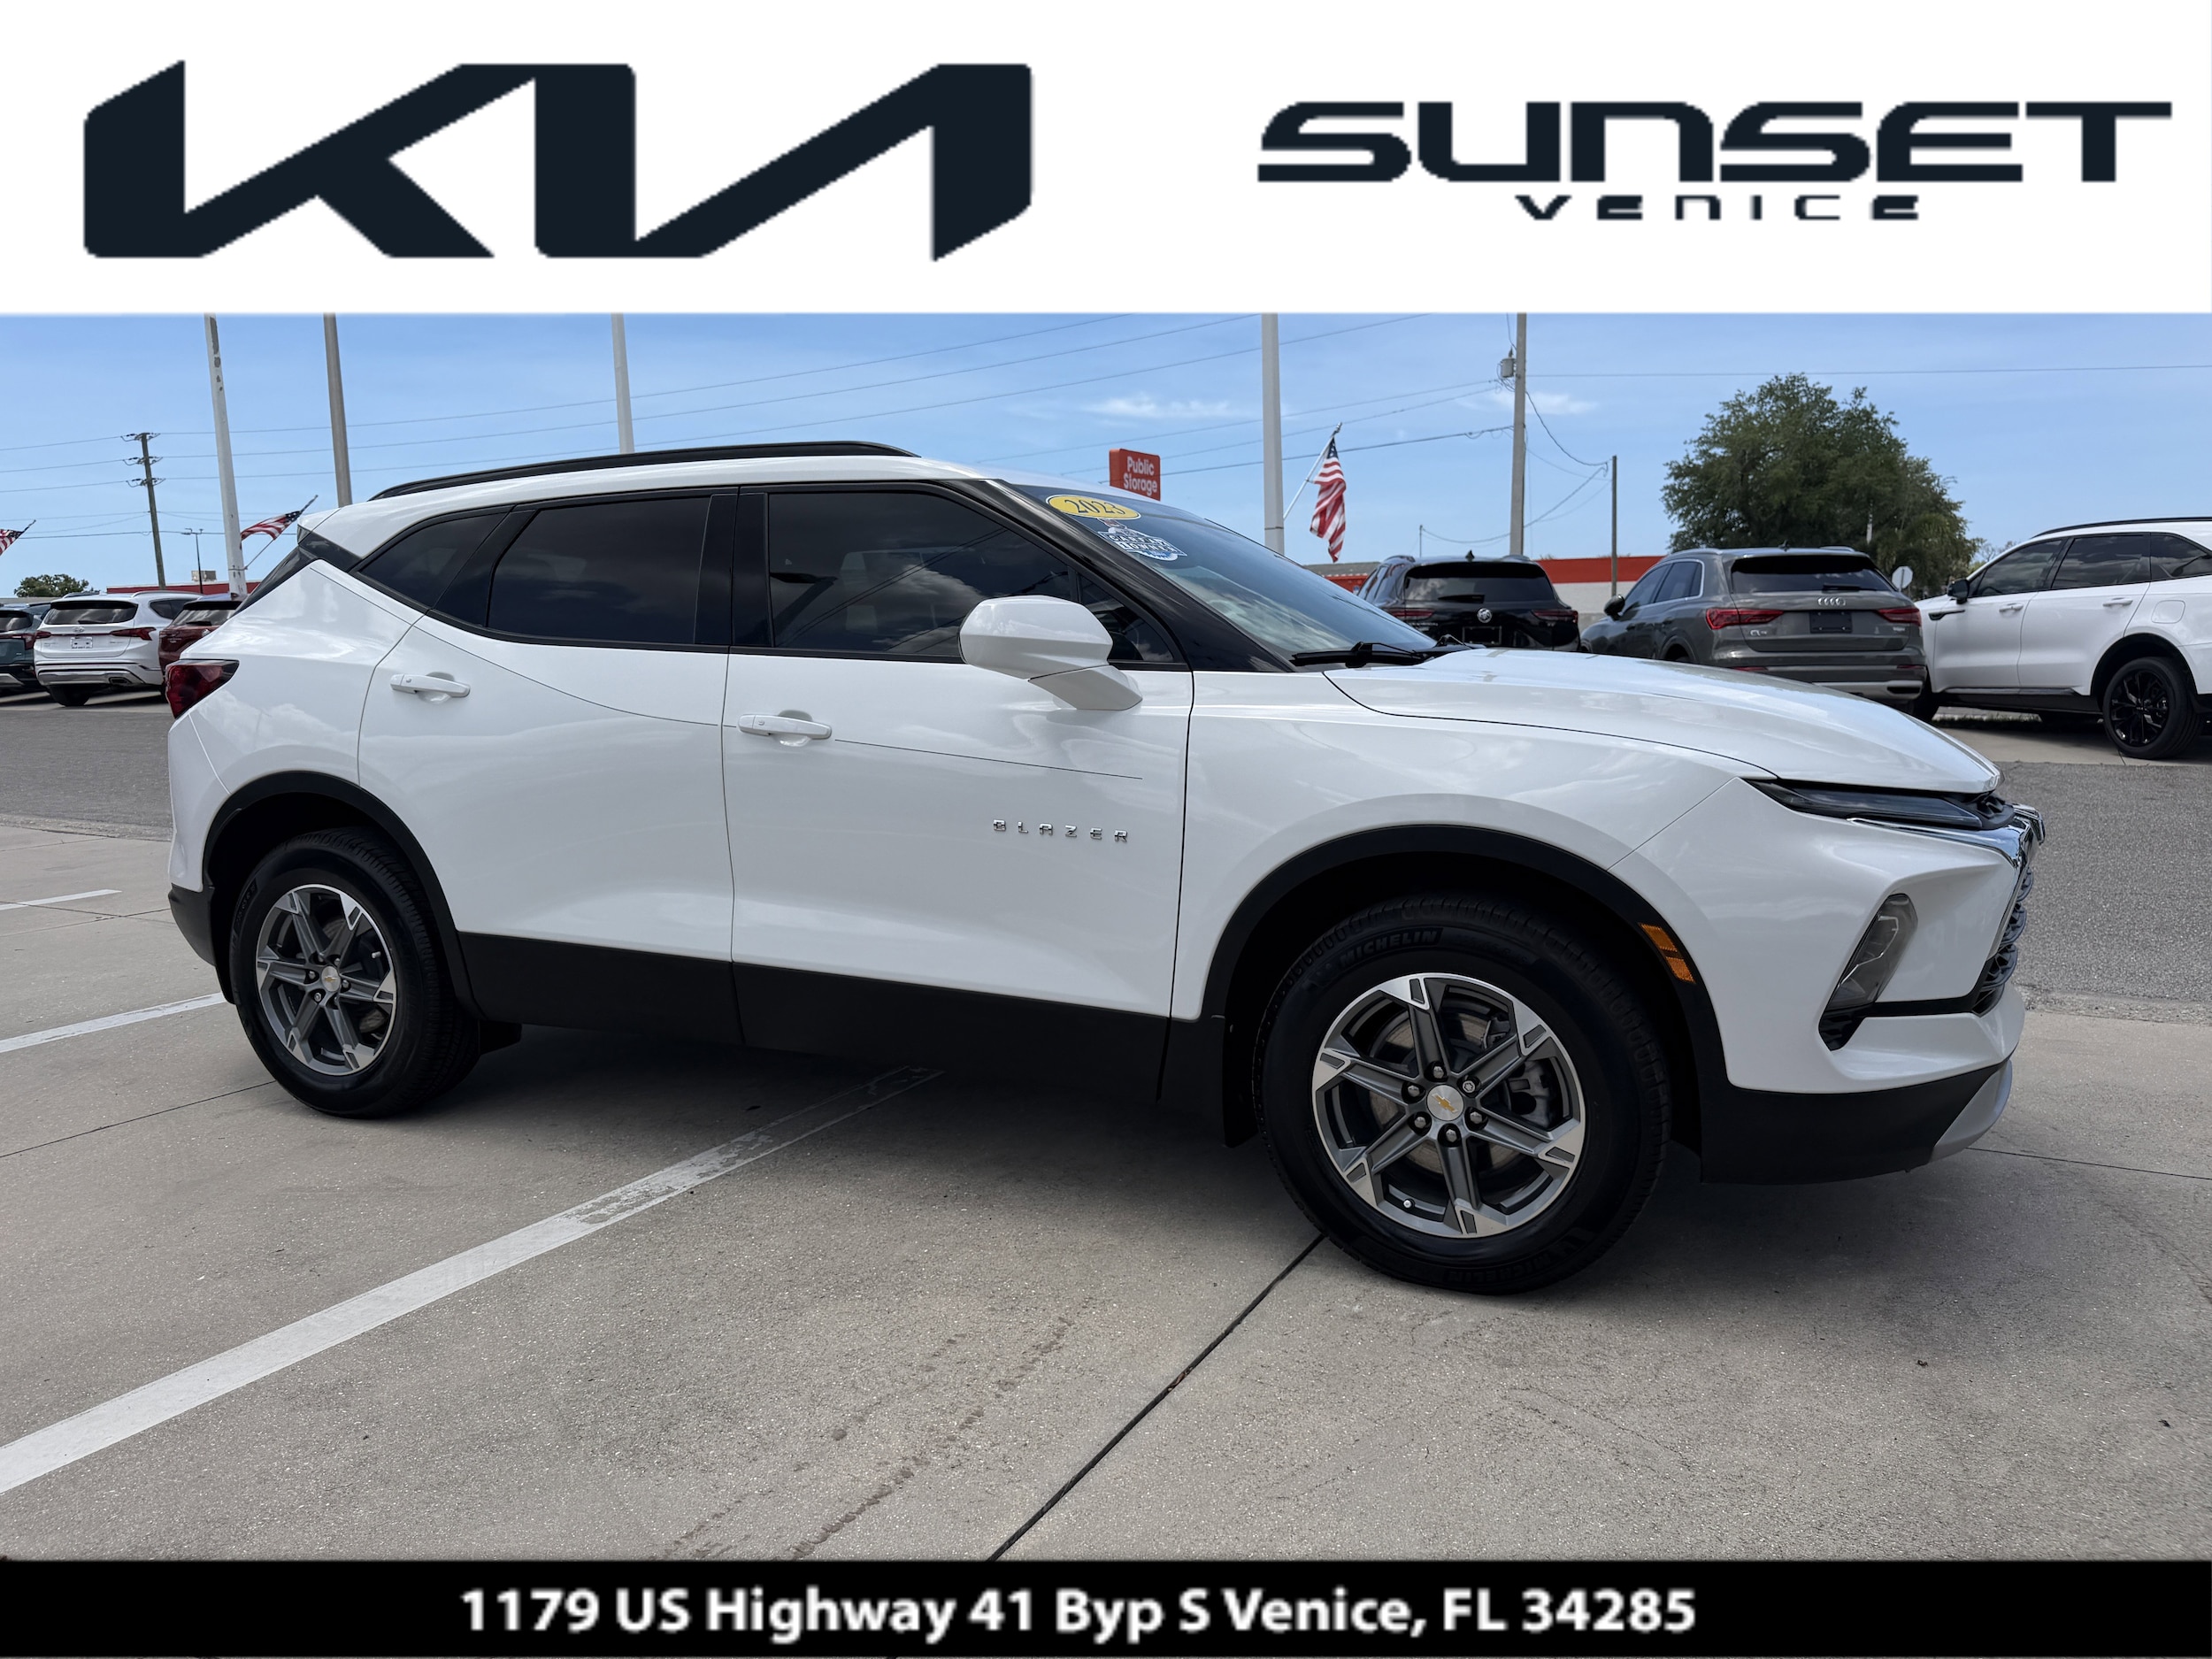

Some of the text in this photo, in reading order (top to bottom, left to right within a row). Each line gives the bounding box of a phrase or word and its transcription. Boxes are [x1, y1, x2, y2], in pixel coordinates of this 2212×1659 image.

[1126, 456, 1155, 476] Public
[1124, 472, 1157, 496] Storage
[1064, 499, 1125, 515] 2023
[993, 818, 1128, 842] BLAZER
[1340, 929, 1440, 969] MICHELIN
